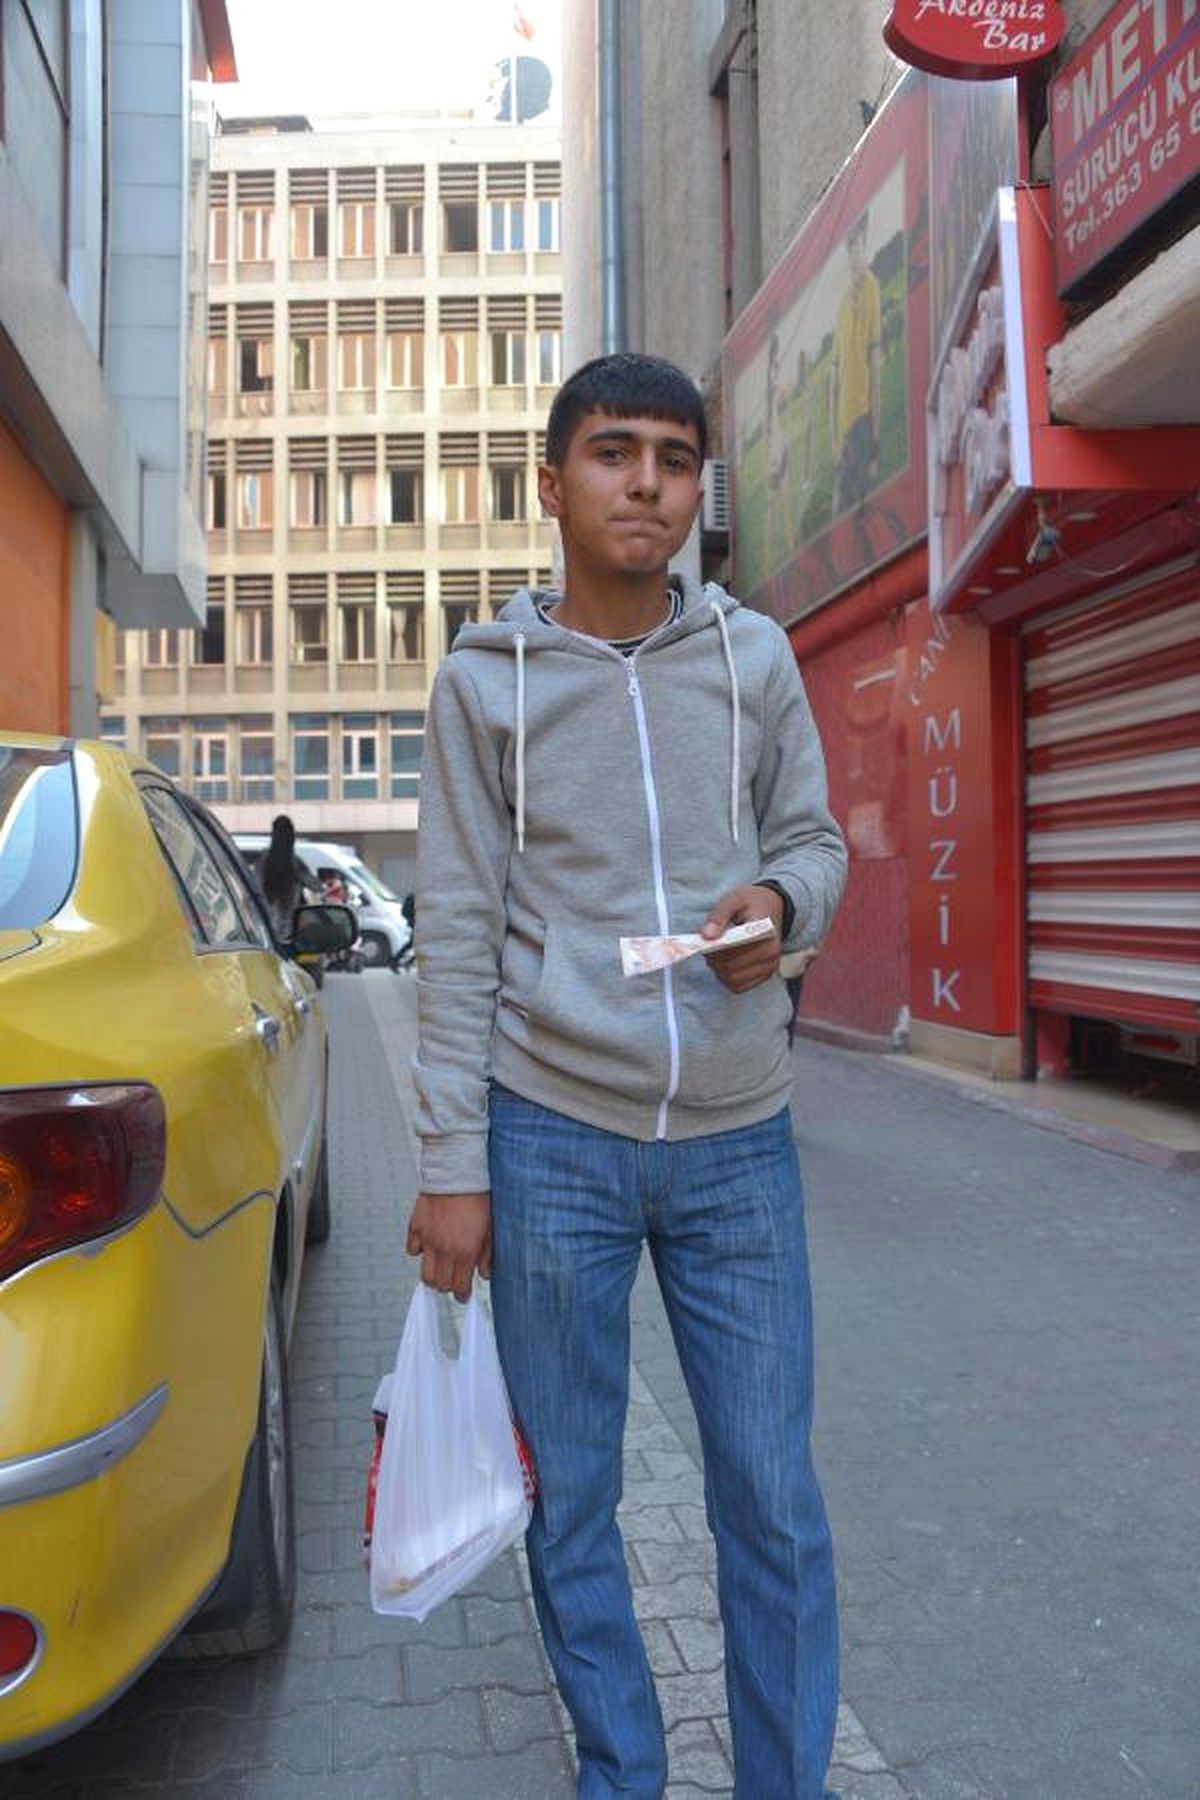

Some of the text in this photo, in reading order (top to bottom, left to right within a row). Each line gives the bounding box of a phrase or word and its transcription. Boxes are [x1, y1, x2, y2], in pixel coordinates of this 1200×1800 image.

[973, 19, 1046, 51] Bar
[1073, 0, 1200, 143] MET
[1151, 121, 1181, 172] 65
